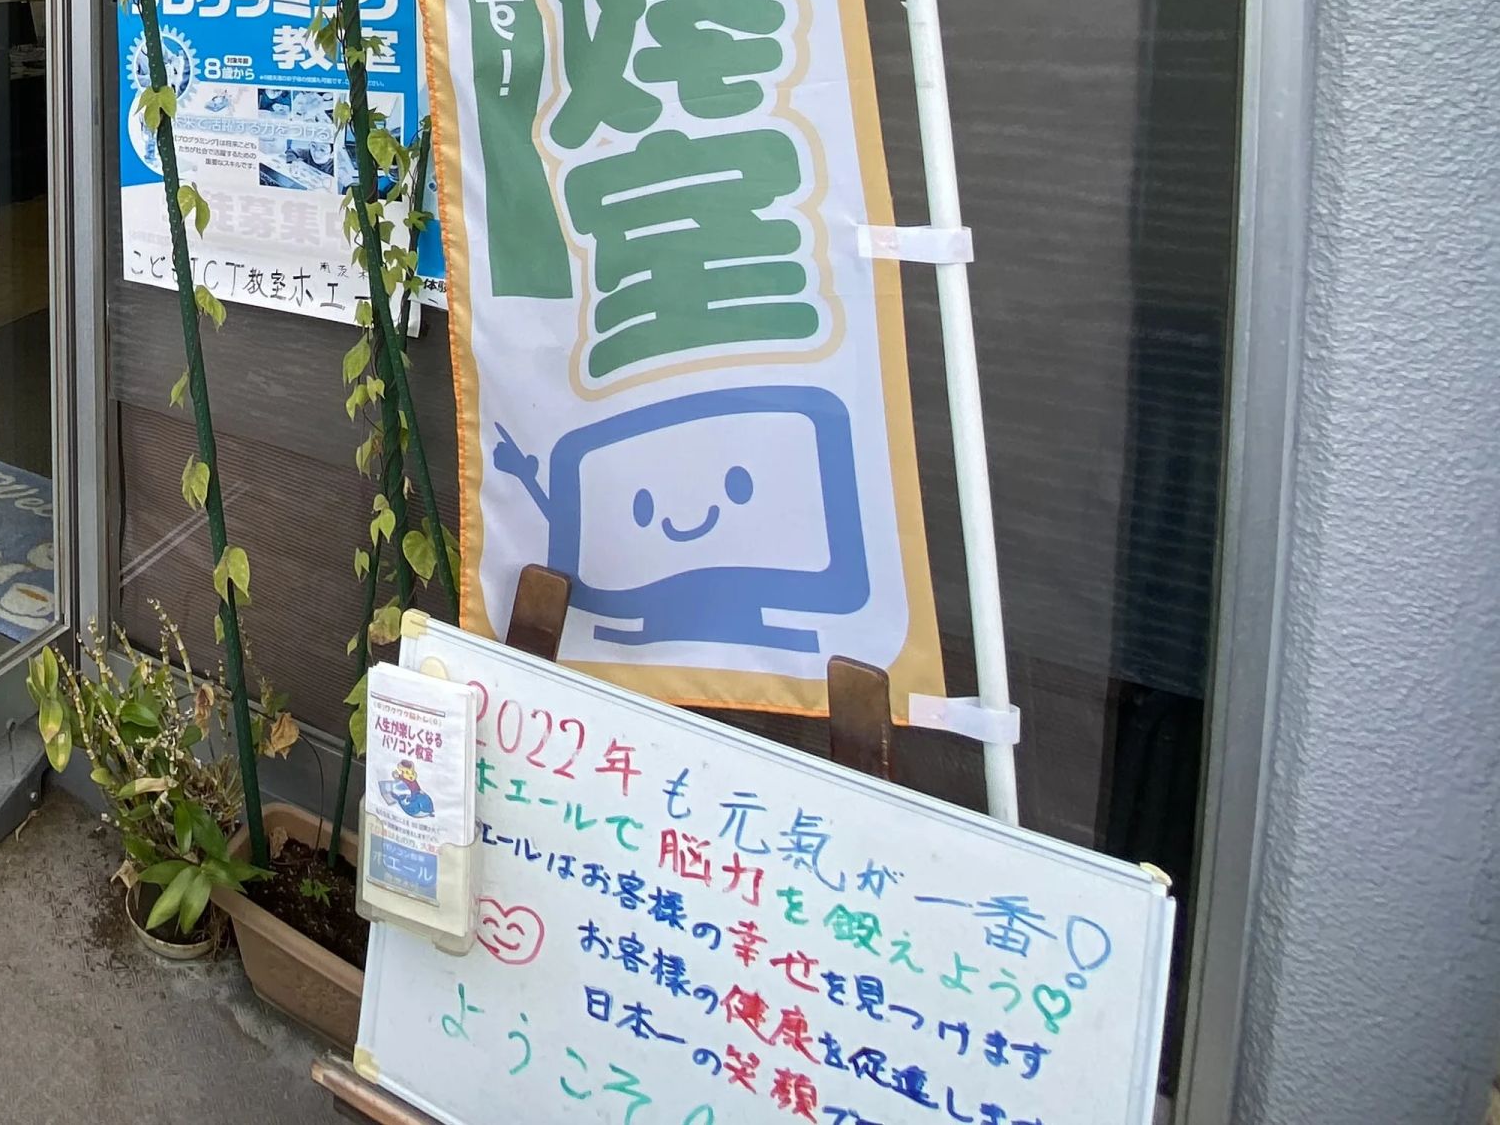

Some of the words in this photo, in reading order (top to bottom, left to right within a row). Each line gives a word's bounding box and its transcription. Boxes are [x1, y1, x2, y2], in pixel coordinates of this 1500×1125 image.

[374, 716, 443, 749] 人生が楽しくなる
[382, 733, 435, 764] パソコン教室
[578, 918, 1045, 1125] お客様の健康を促進しま
